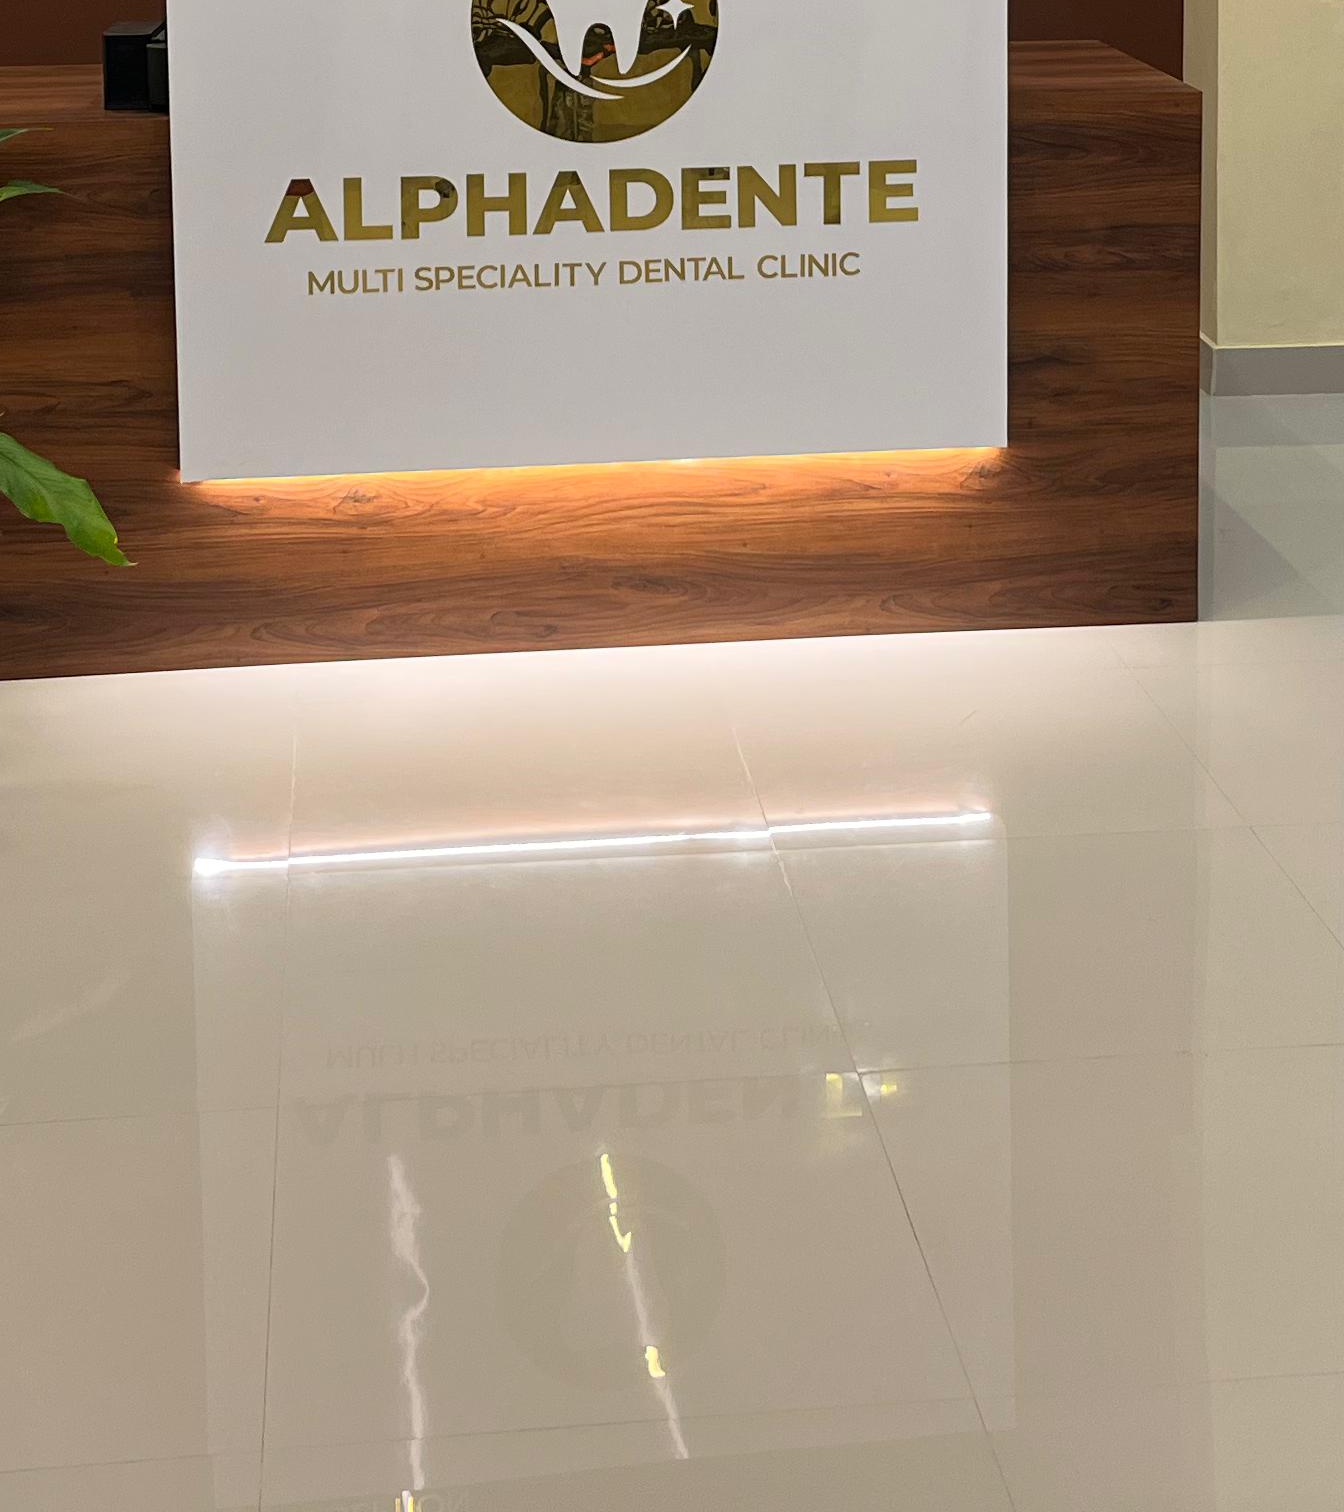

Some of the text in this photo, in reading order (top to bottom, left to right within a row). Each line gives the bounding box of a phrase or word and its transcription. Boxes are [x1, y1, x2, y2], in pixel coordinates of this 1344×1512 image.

[264, 159, 920, 243] ALPHADENTE
[307, 251, 862, 296] MULTI SPECIALITY DENTAL CLINIC
